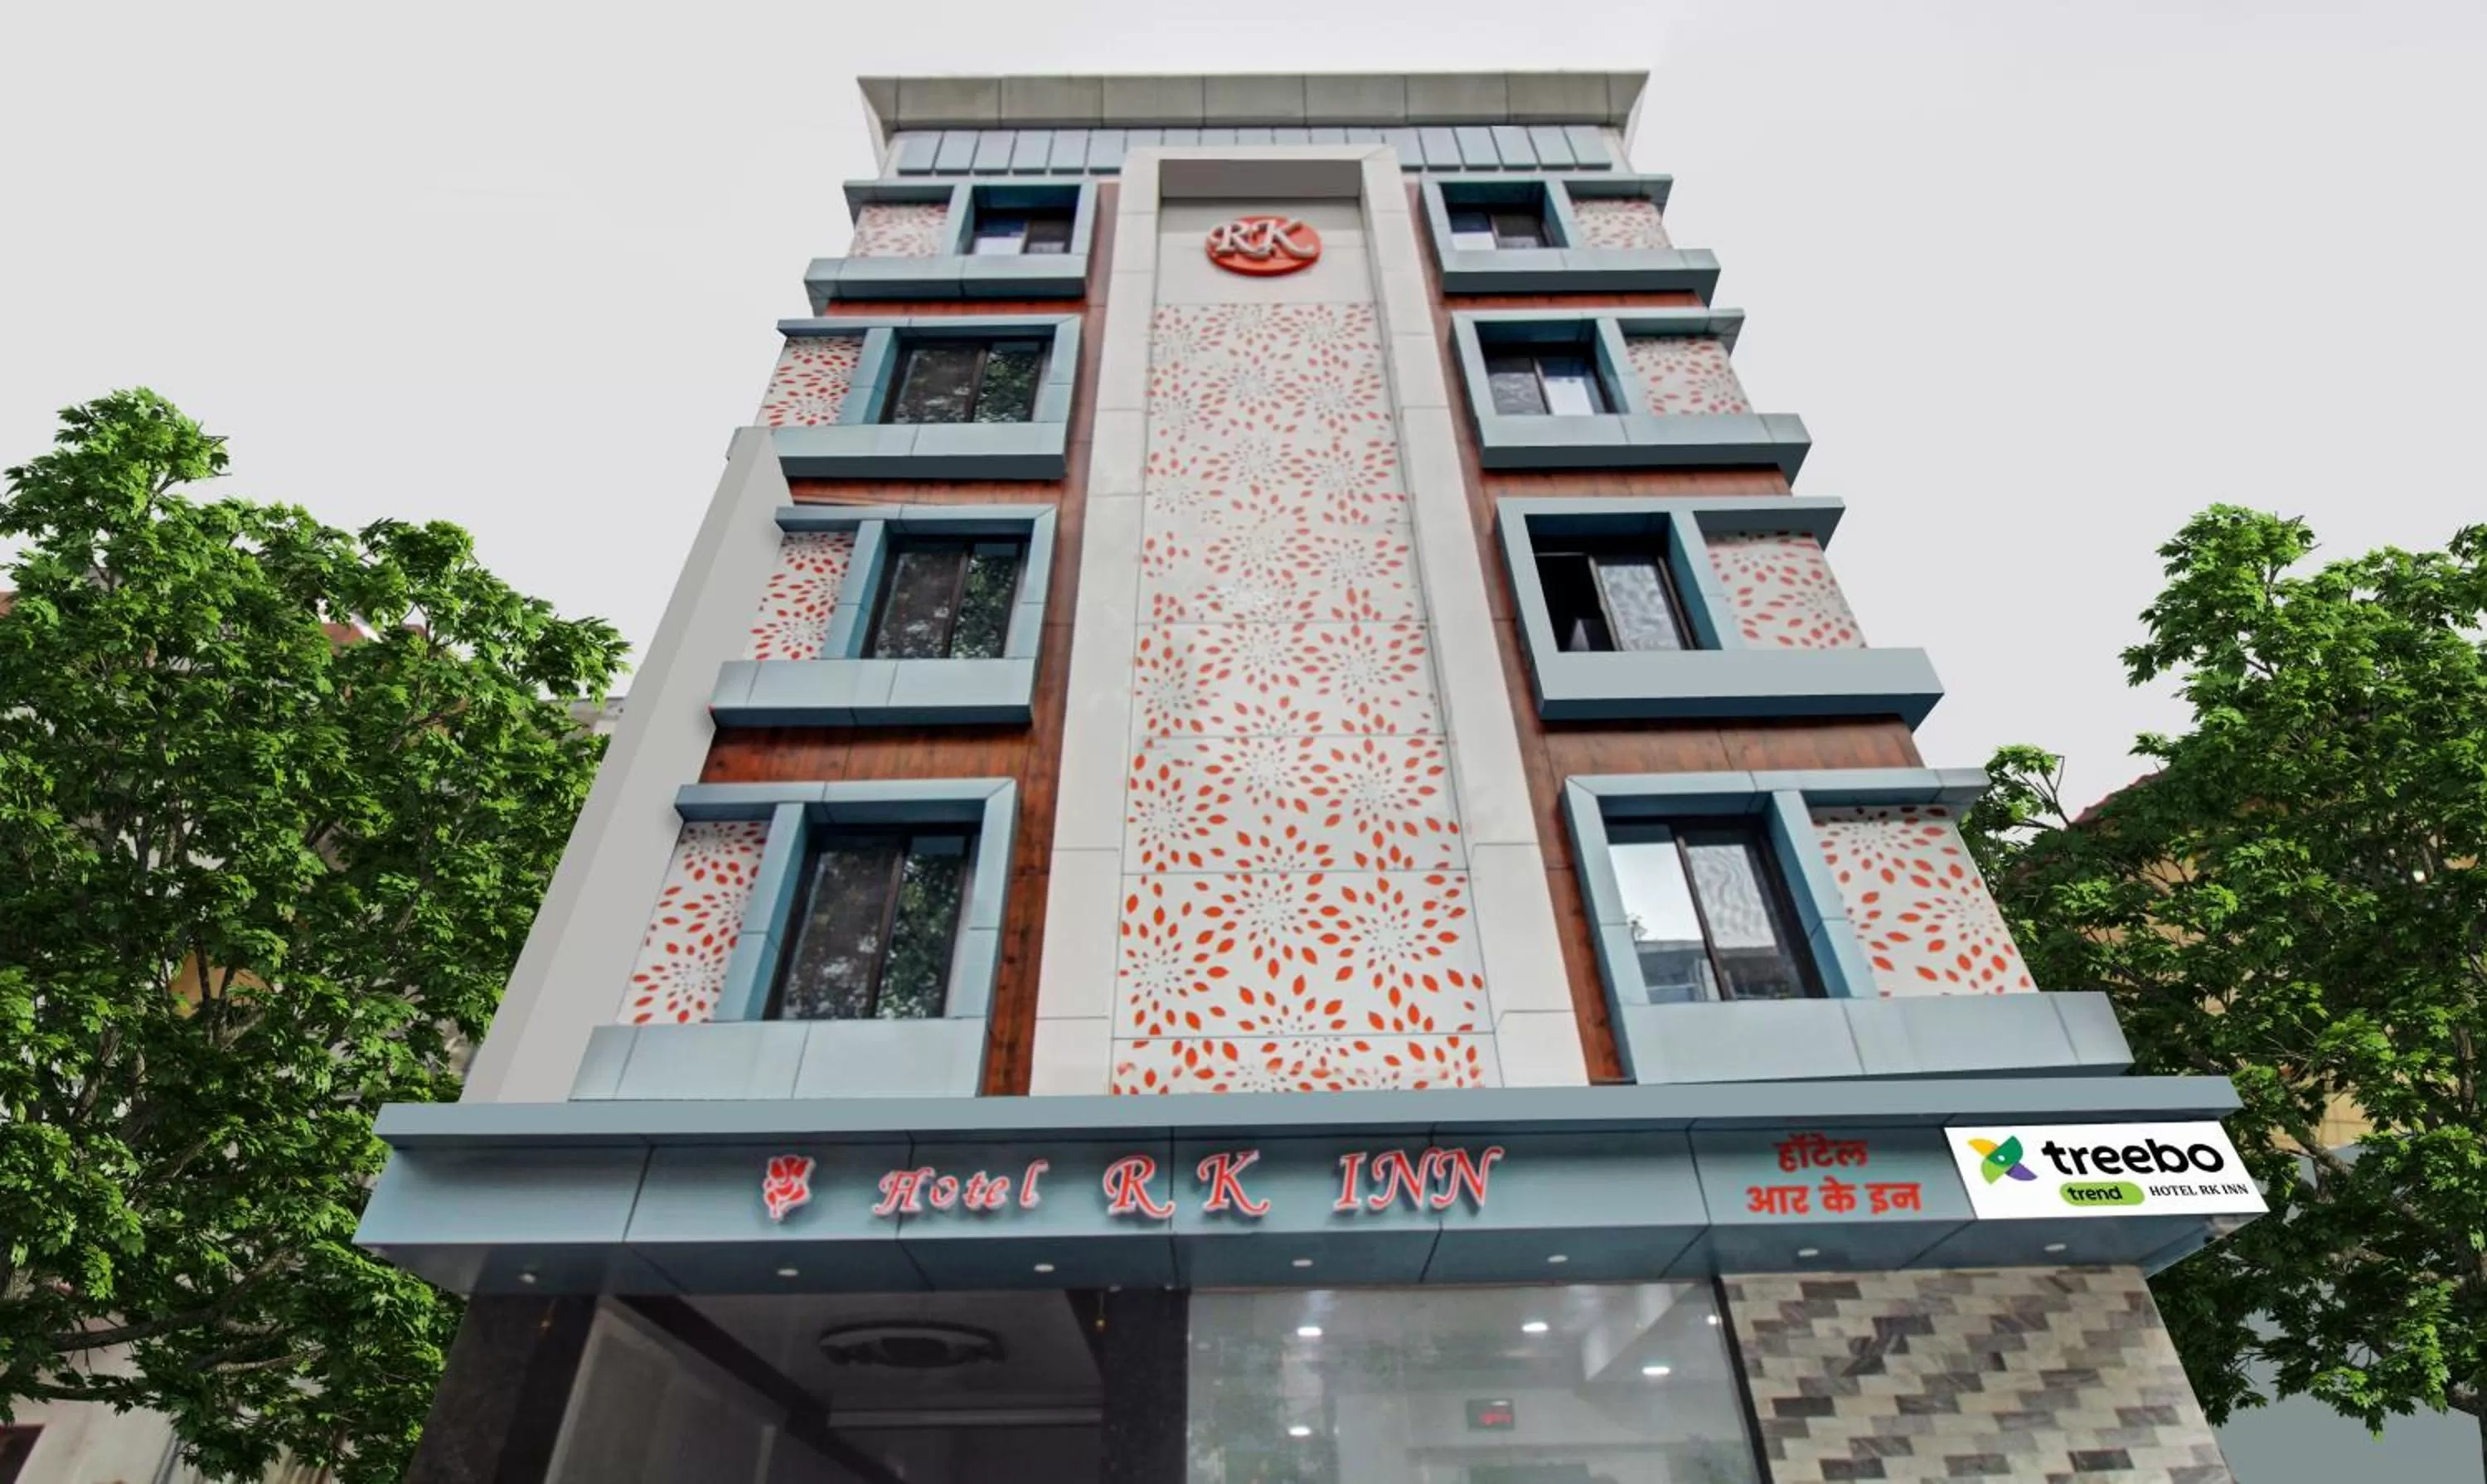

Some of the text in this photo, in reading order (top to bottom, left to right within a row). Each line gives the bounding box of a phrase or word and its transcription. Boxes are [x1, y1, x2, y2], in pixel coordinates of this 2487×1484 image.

[1206, 217, 1315, 258] RK
[2040, 1138, 2225, 1176] treebo
[872, 1147, 1505, 1219] Hotel R K INN
[1745, 1174, 1922, 1215] आर के इन
[2067, 1186, 2123, 1201] trend
[2150, 1183, 2249, 1197] HOTEL RK INN
